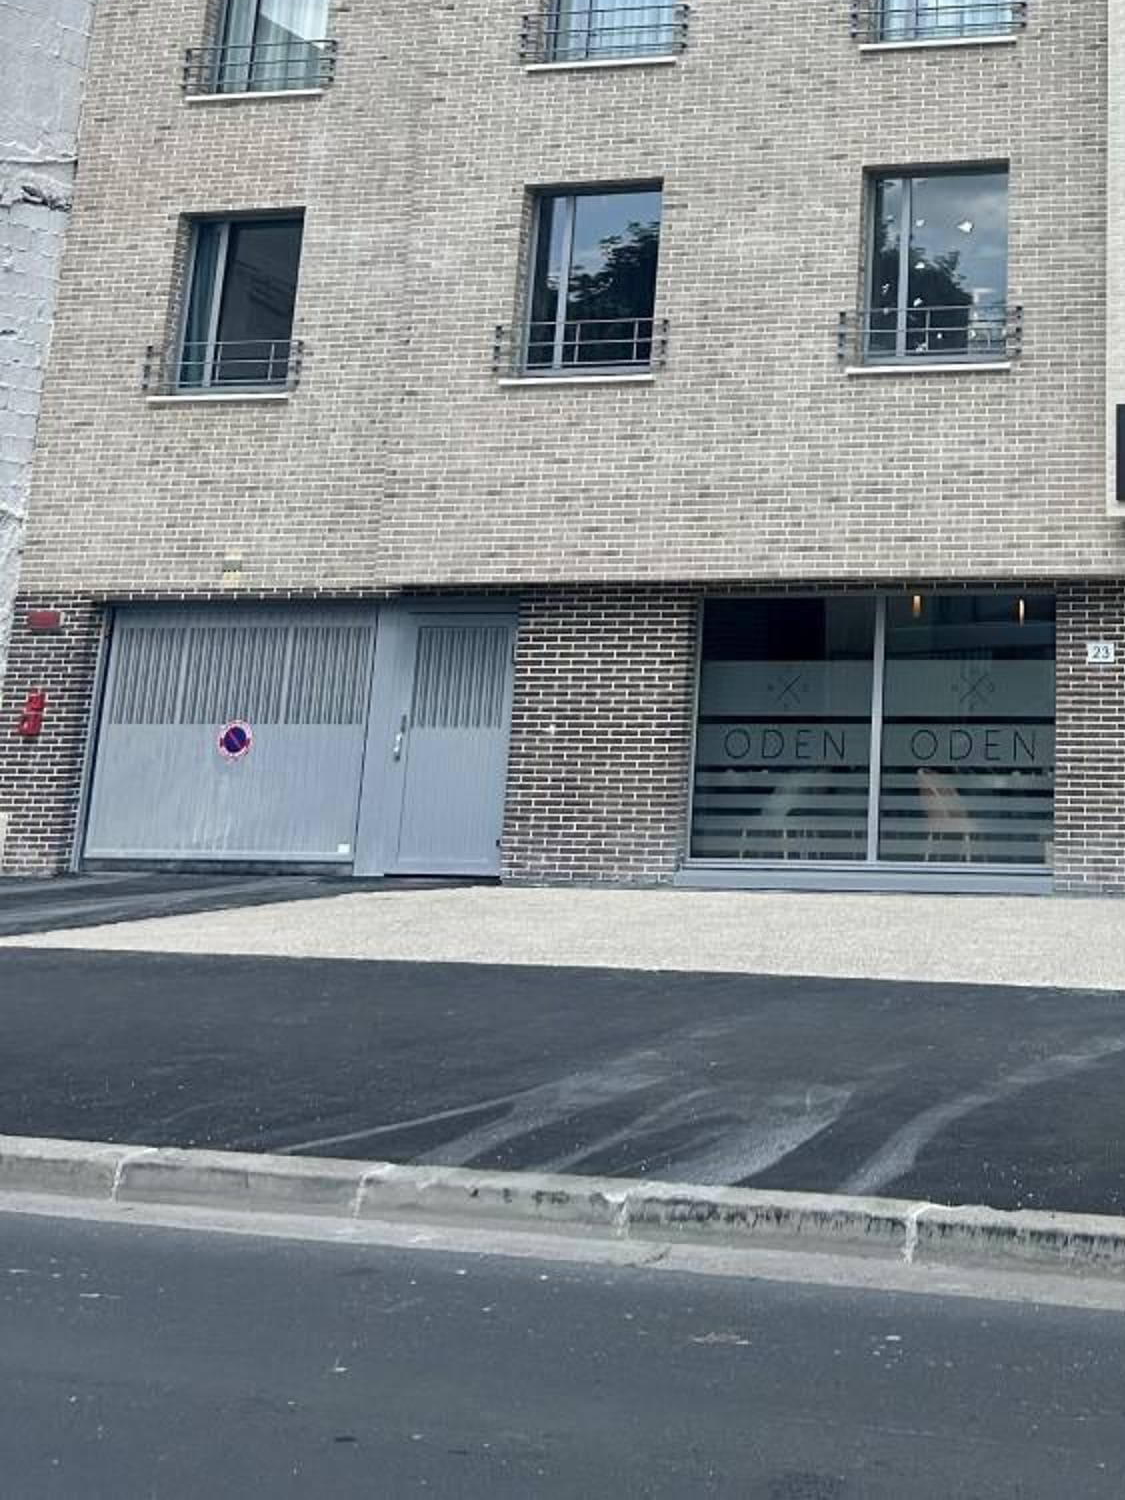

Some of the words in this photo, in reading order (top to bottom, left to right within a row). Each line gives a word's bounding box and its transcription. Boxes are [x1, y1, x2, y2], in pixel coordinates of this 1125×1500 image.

[1092, 645, 1110, 659] 23
[724, 728, 846, 760] ODEN
[910, 728, 1036, 762] ODEN
